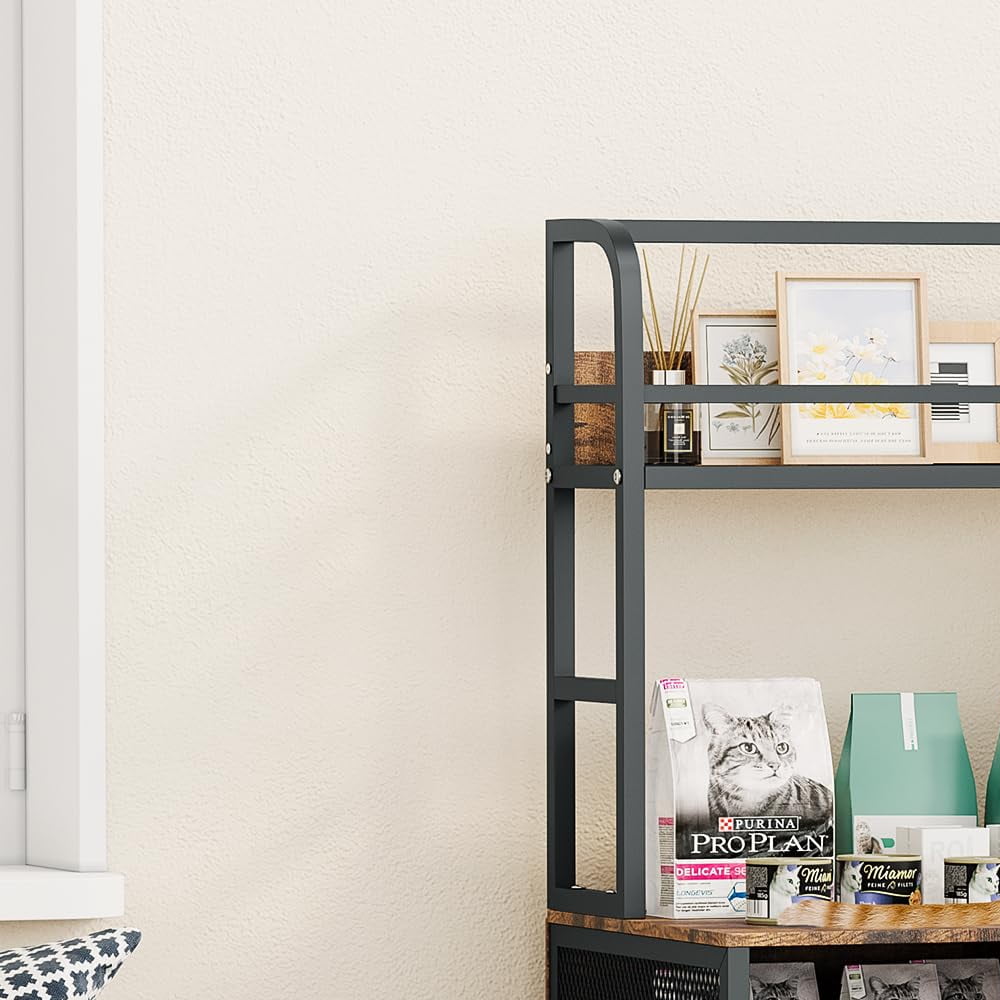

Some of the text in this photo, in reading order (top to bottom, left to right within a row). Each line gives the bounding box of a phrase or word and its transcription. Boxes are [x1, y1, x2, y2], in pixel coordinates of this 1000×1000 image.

[735, 818, 796, 830] PURINA
[690, 833, 746, 854] PRO
[748, 832, 826, 856] PLAN
[676, 867, 730, 877] DELICATE
[863, 864, 918, 880] Miamor
[676, 889, 713, 897] LONGEVIS
